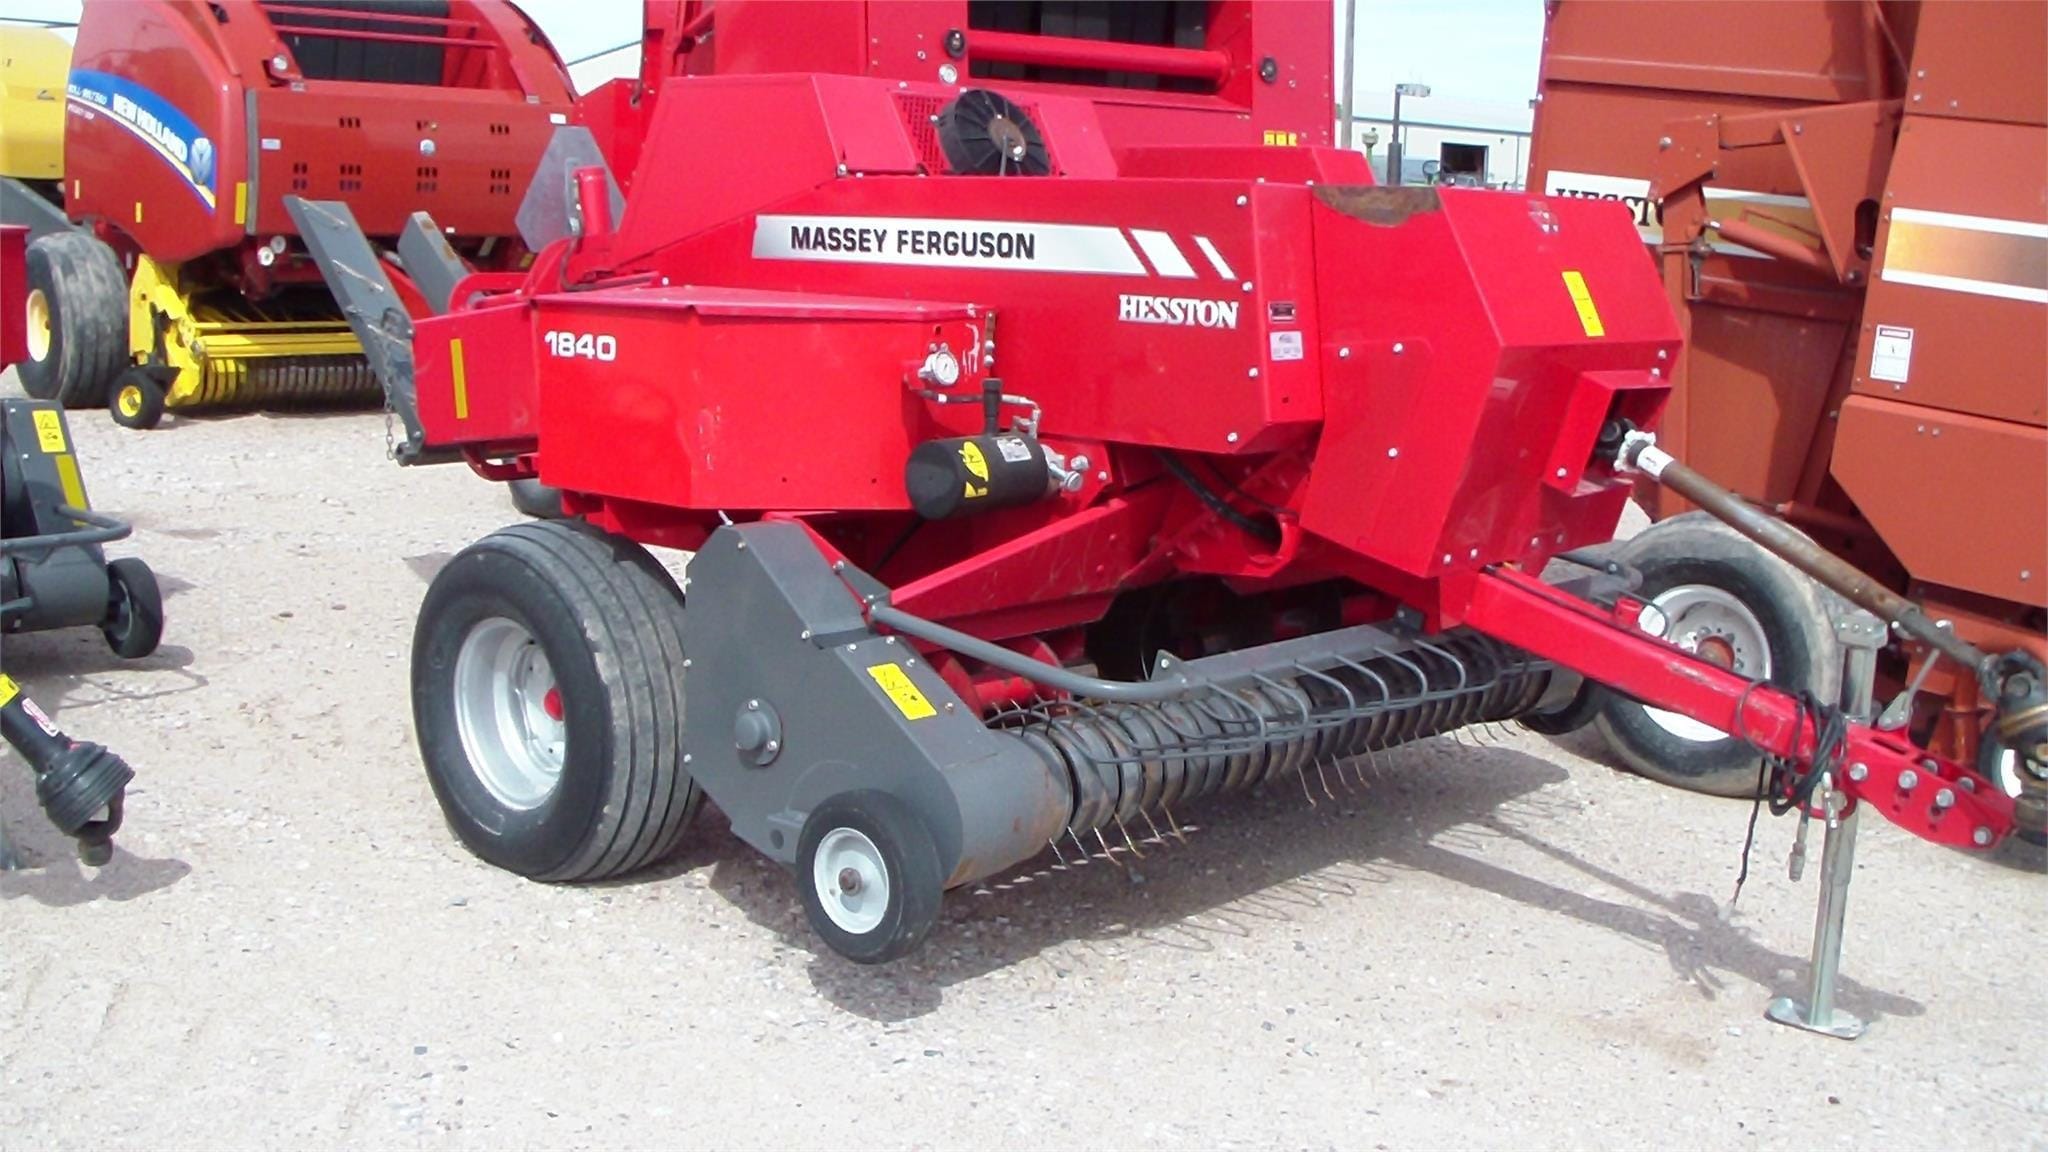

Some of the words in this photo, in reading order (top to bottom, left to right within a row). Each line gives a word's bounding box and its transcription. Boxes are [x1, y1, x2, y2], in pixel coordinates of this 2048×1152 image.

[113, 92, 137, 122] NEW
[136, 107, 188, 162] HOLLAND
[791, 225, 887, 252] MASSEY
[897, 230, 1035, 259] FERGUSON
[1118, 294, 1239, 329] HESSTON
[544, 330, 617, 361] 1840
